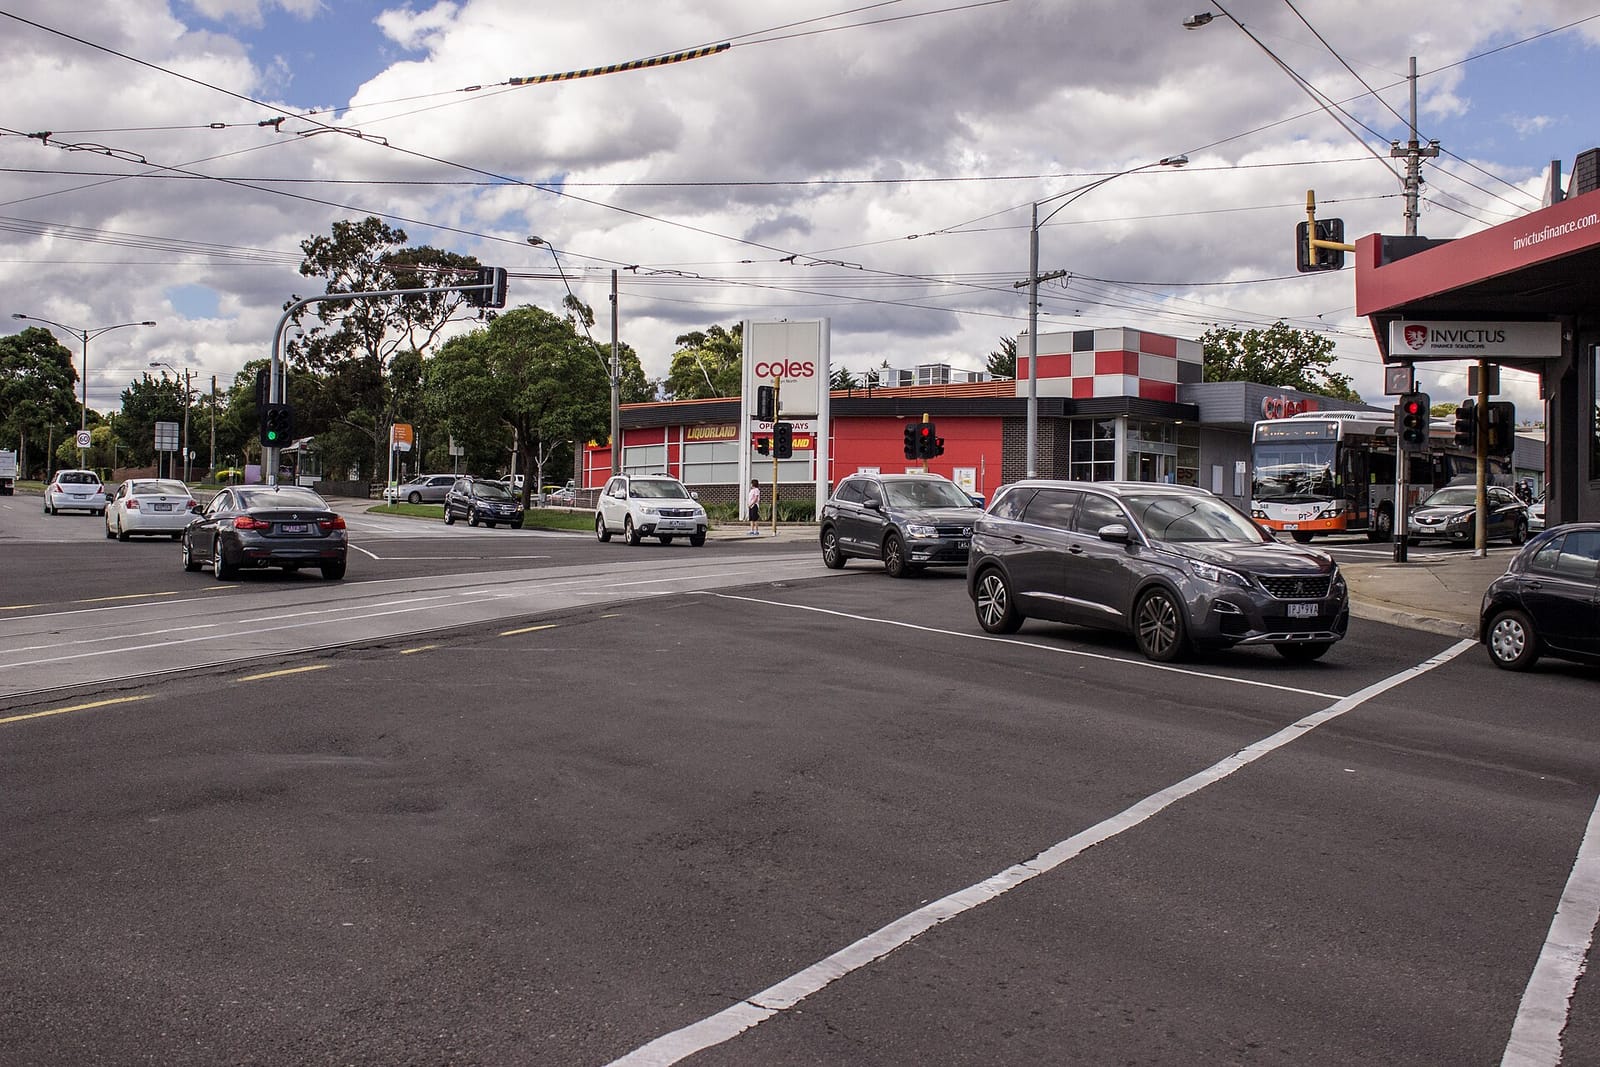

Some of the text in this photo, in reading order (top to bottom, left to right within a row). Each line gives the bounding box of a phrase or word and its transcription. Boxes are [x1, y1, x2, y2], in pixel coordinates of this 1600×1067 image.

[1431, 330, 1505, 343] INVICTUS
[755, 359, 815, 378] coles
[687, 426, 736, 439] LIQUORLAND
